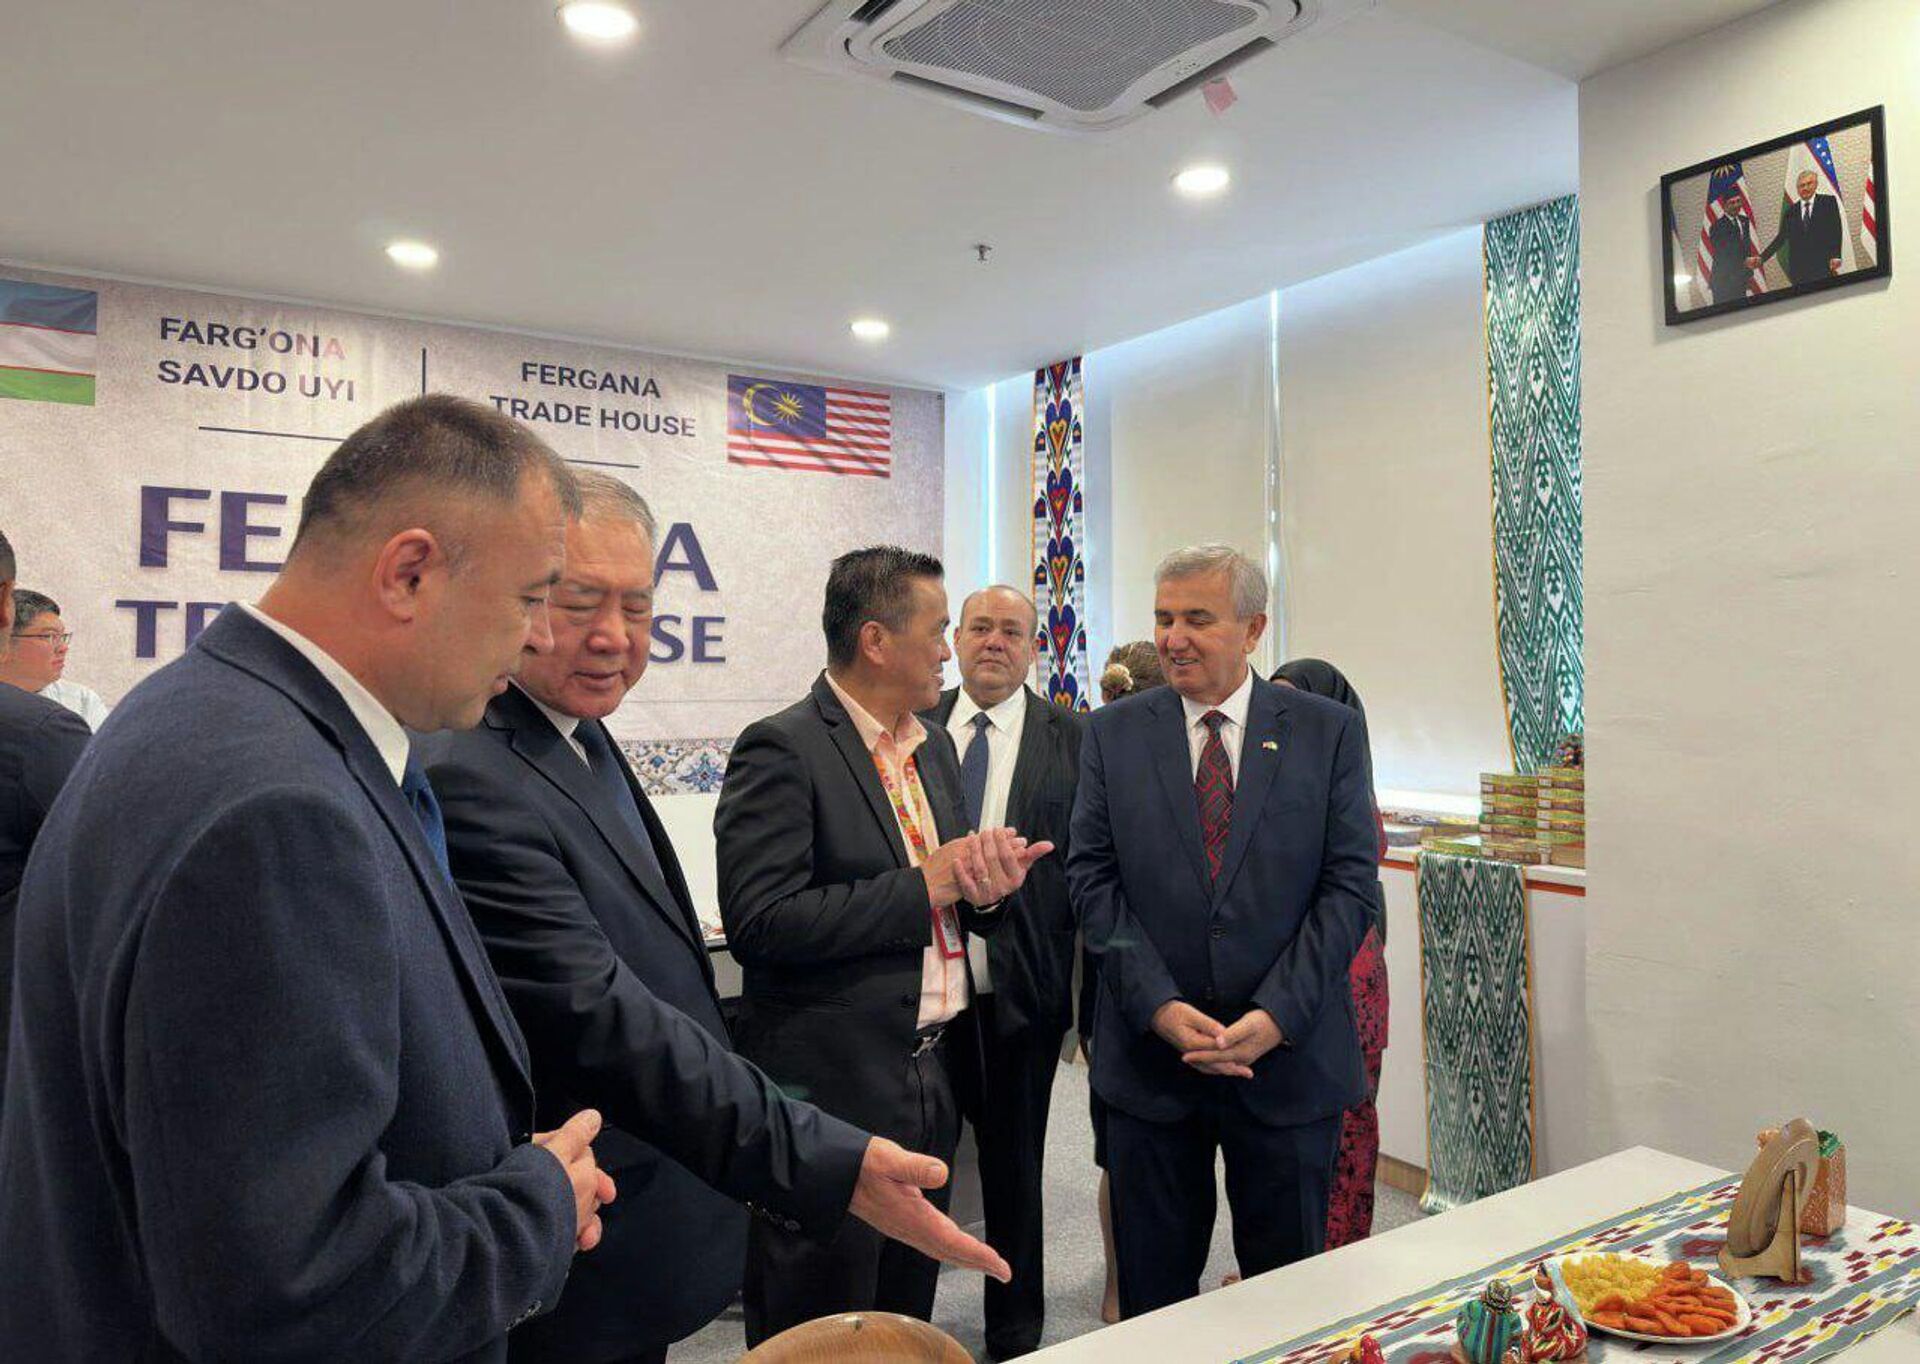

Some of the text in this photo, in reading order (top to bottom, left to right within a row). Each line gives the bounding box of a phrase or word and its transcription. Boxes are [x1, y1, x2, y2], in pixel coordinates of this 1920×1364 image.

[157, 359, 355, 402] SAVDO UYI
[521, 361, 661, 398] FERGANA
[489, 395, 696, 438] TRADE HOUSE
